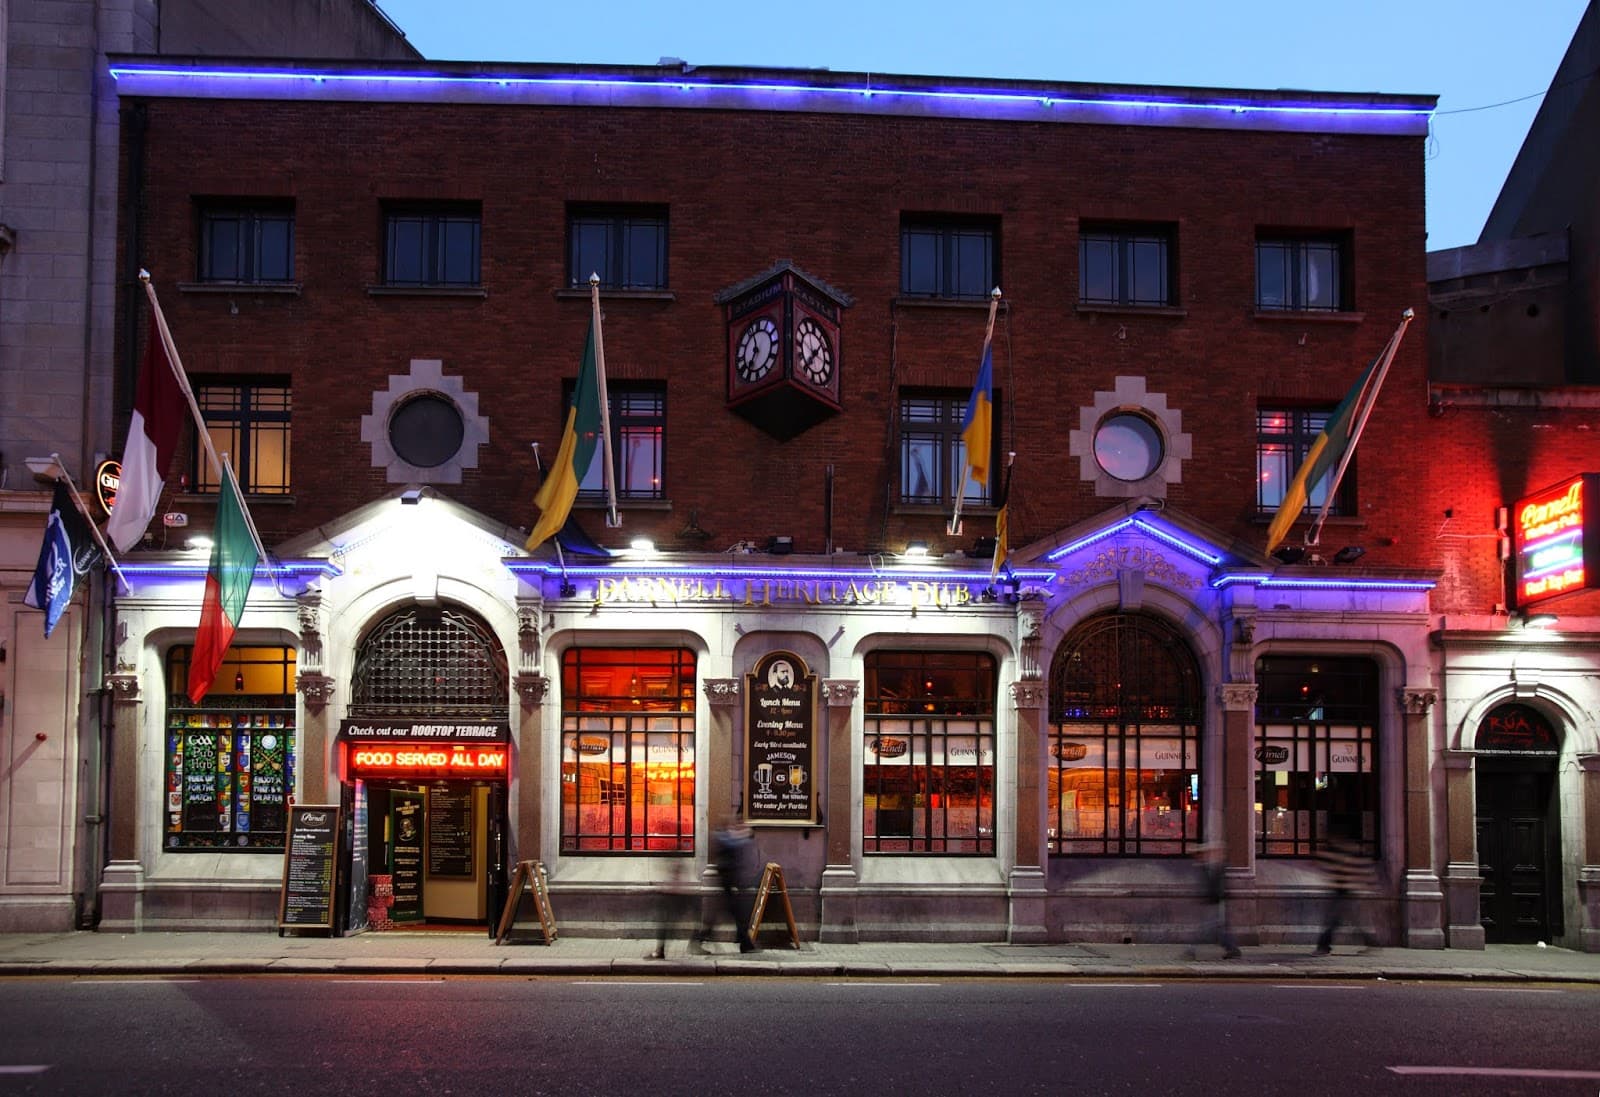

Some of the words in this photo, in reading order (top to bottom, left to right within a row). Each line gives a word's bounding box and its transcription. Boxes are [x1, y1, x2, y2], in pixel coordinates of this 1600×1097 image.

[1521, 481, 1584, 529] Parnell
[908, 580, 970, 610] PUB
[782, 698, 801, 706] Menu
[348, 725, 374, 736] Check
[376, 726, 390, 736] out
[392, 728, 409, 736] our
[411, 725, 454, 737] ROOFTOP
[456, 726, 498, 737] TERRACE
[757, 720, 783, 730] Evening
[785, 720, 803, 728] Menu
[193, 746, 214, 758] Pub
[767, 752, 797, 761] JAMESON
[191, 758, 213, 769] Hub
[355, 753, 393, 765] FOOD
[396, 753, 447, 766] SERVED
[451, 754, 474, 766] ALL
[477, 754, 504, 766] DAY
